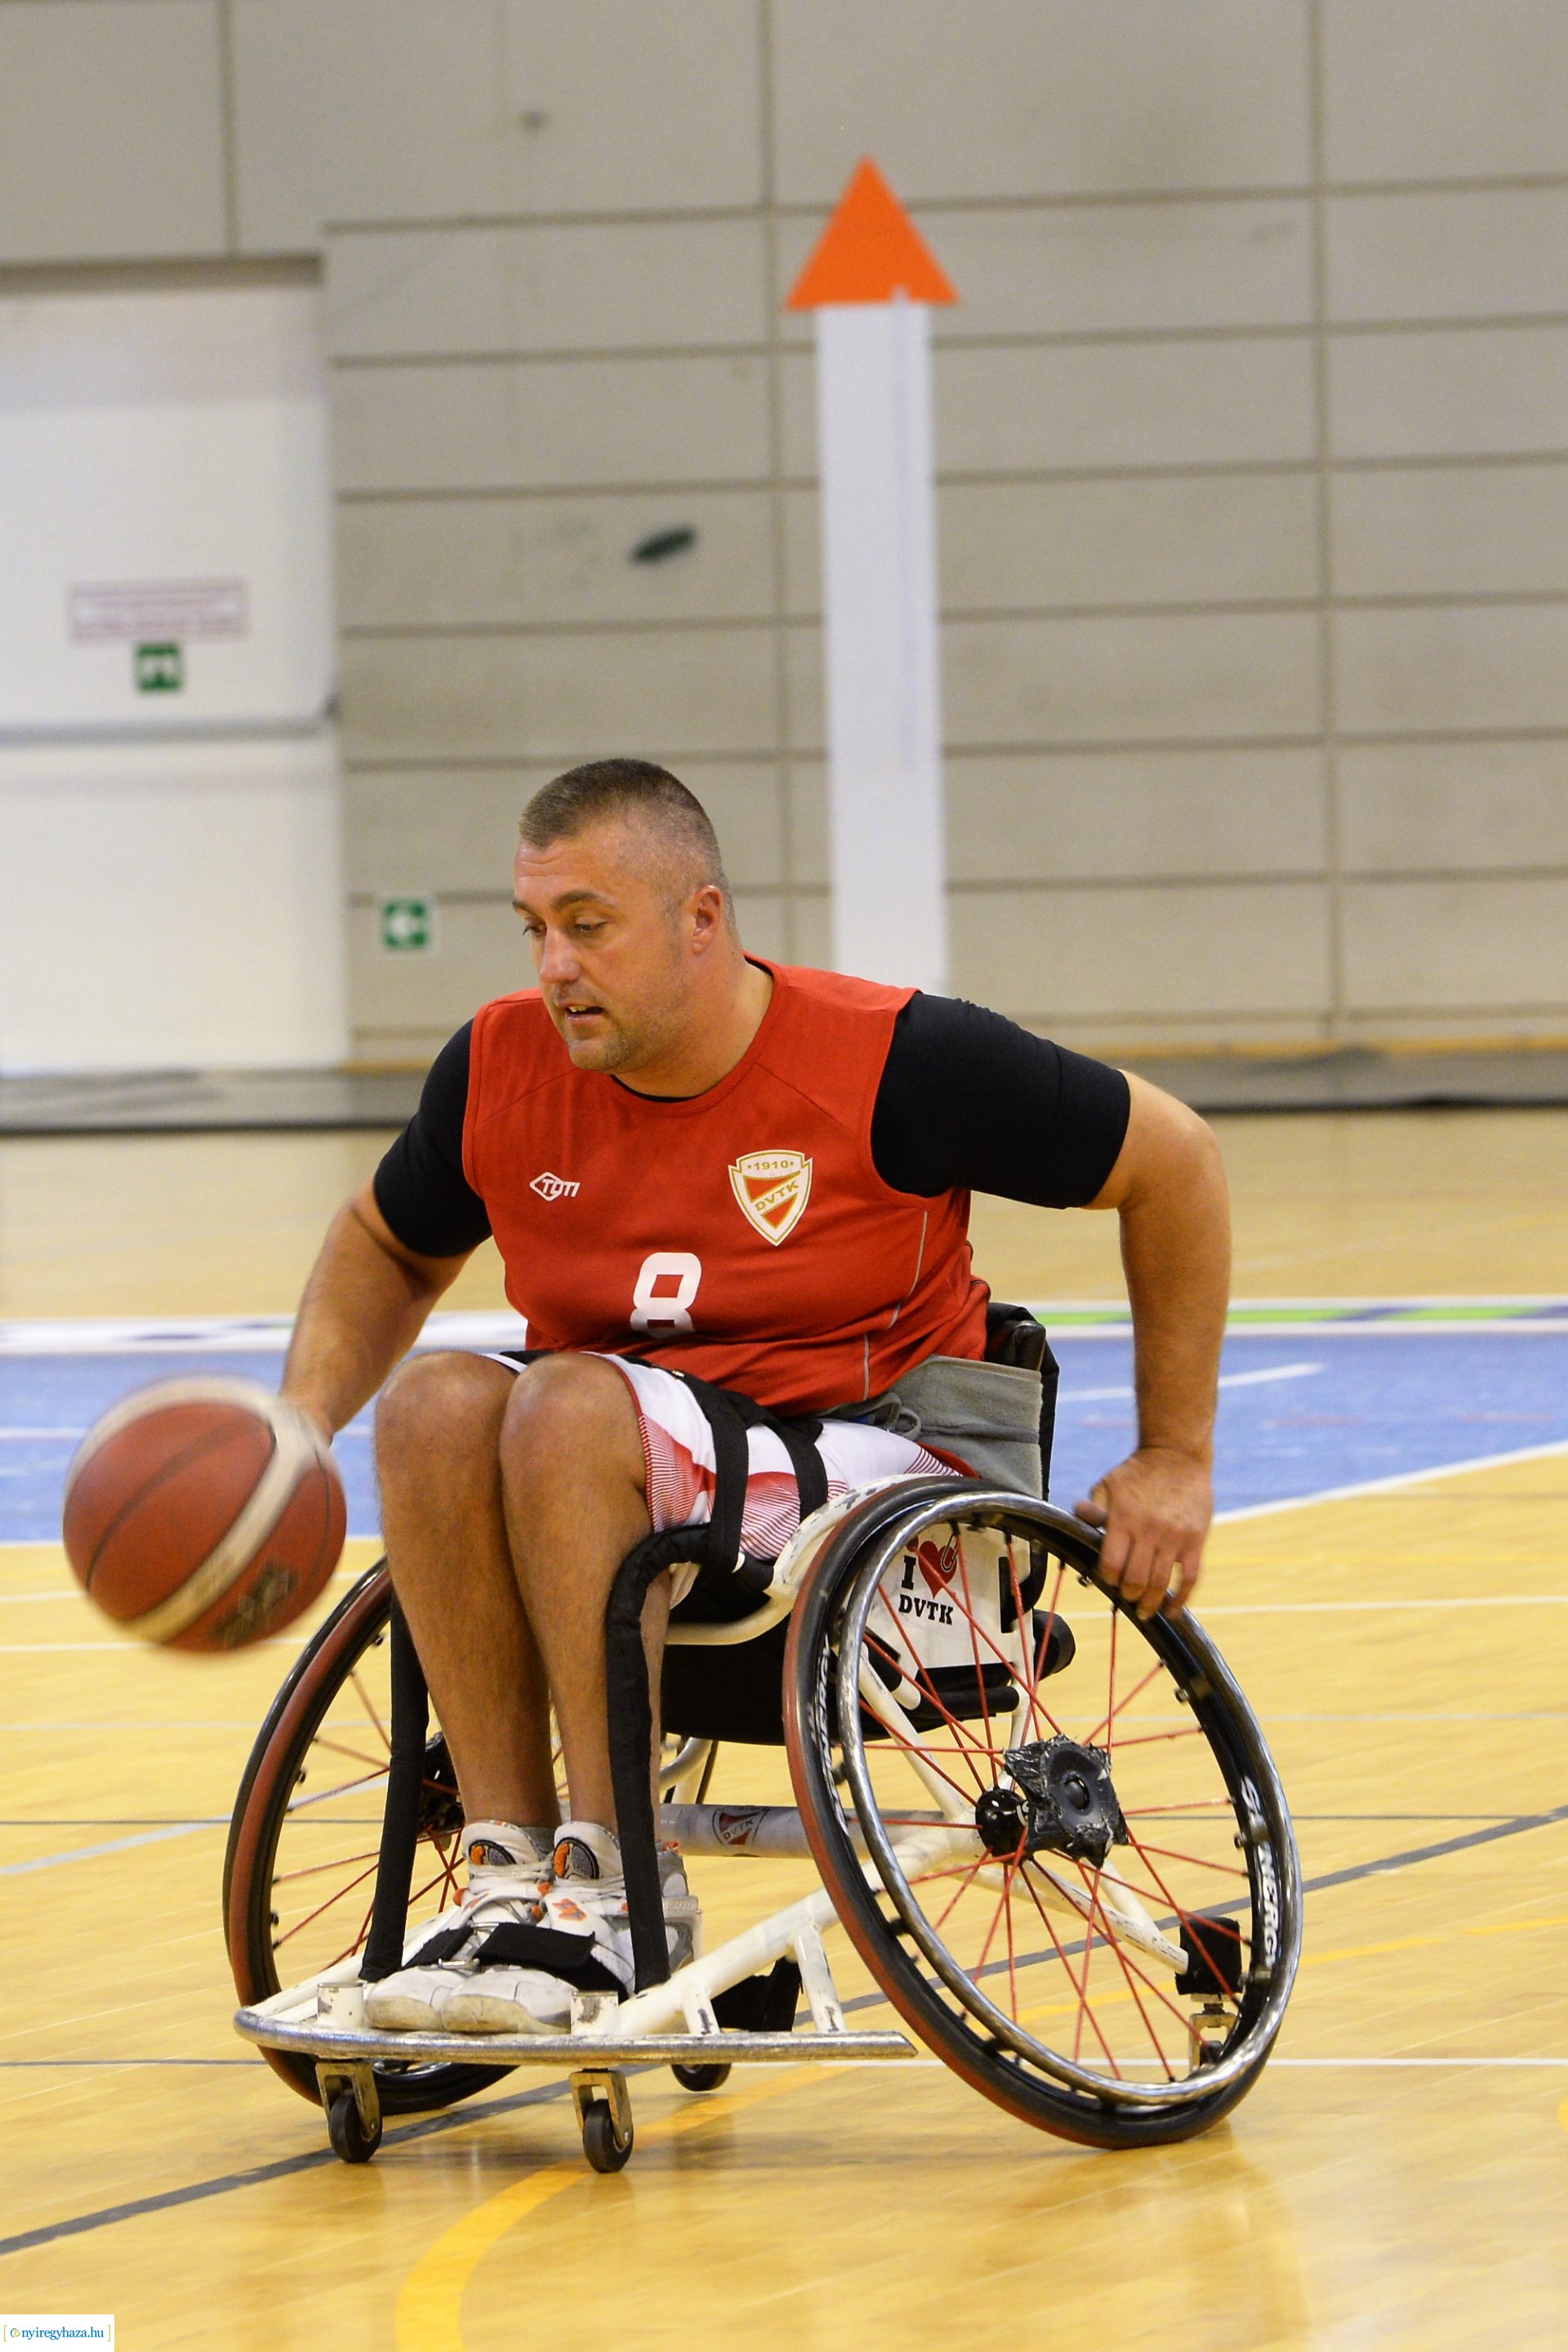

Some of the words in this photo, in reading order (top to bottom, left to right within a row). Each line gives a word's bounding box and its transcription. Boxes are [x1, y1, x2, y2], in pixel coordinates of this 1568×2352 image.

[754, 1160, 789, 1170] 1910
[755, 1179, 800, 1211] DVTK
[630, 1251, 702, 1339] 8
[901, 1554, 917, 1591] I
[898, 1593, 955, 1626] DVTK
